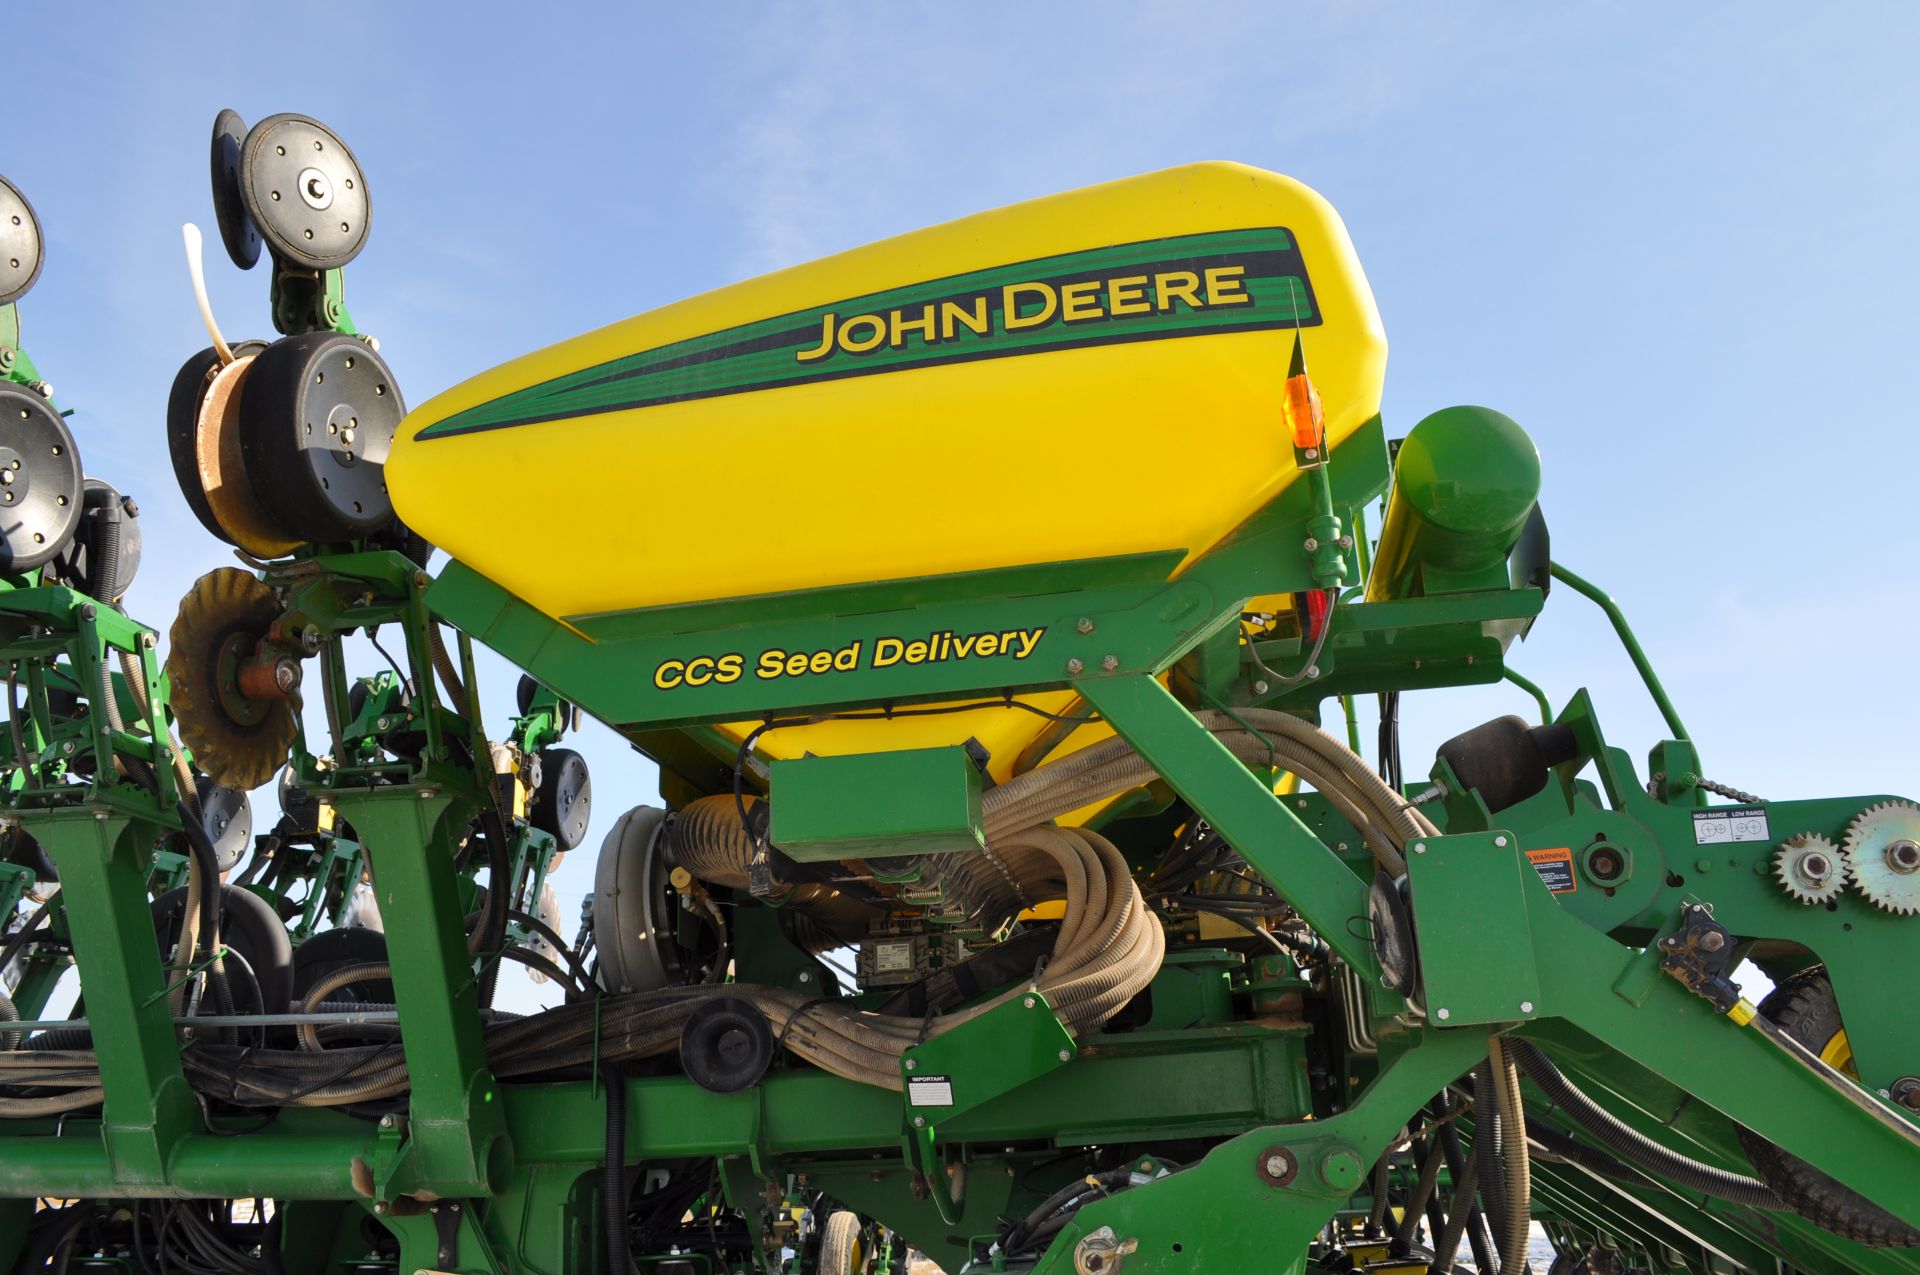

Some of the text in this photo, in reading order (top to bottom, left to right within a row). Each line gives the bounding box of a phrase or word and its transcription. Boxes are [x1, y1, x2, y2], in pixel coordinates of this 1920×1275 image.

[796, 265, 1249, 361] JOHN DEERE
[654, 627, 1045, 690] CCS Seed Delivery
[1533, 852, 1568, 861] WARNING
